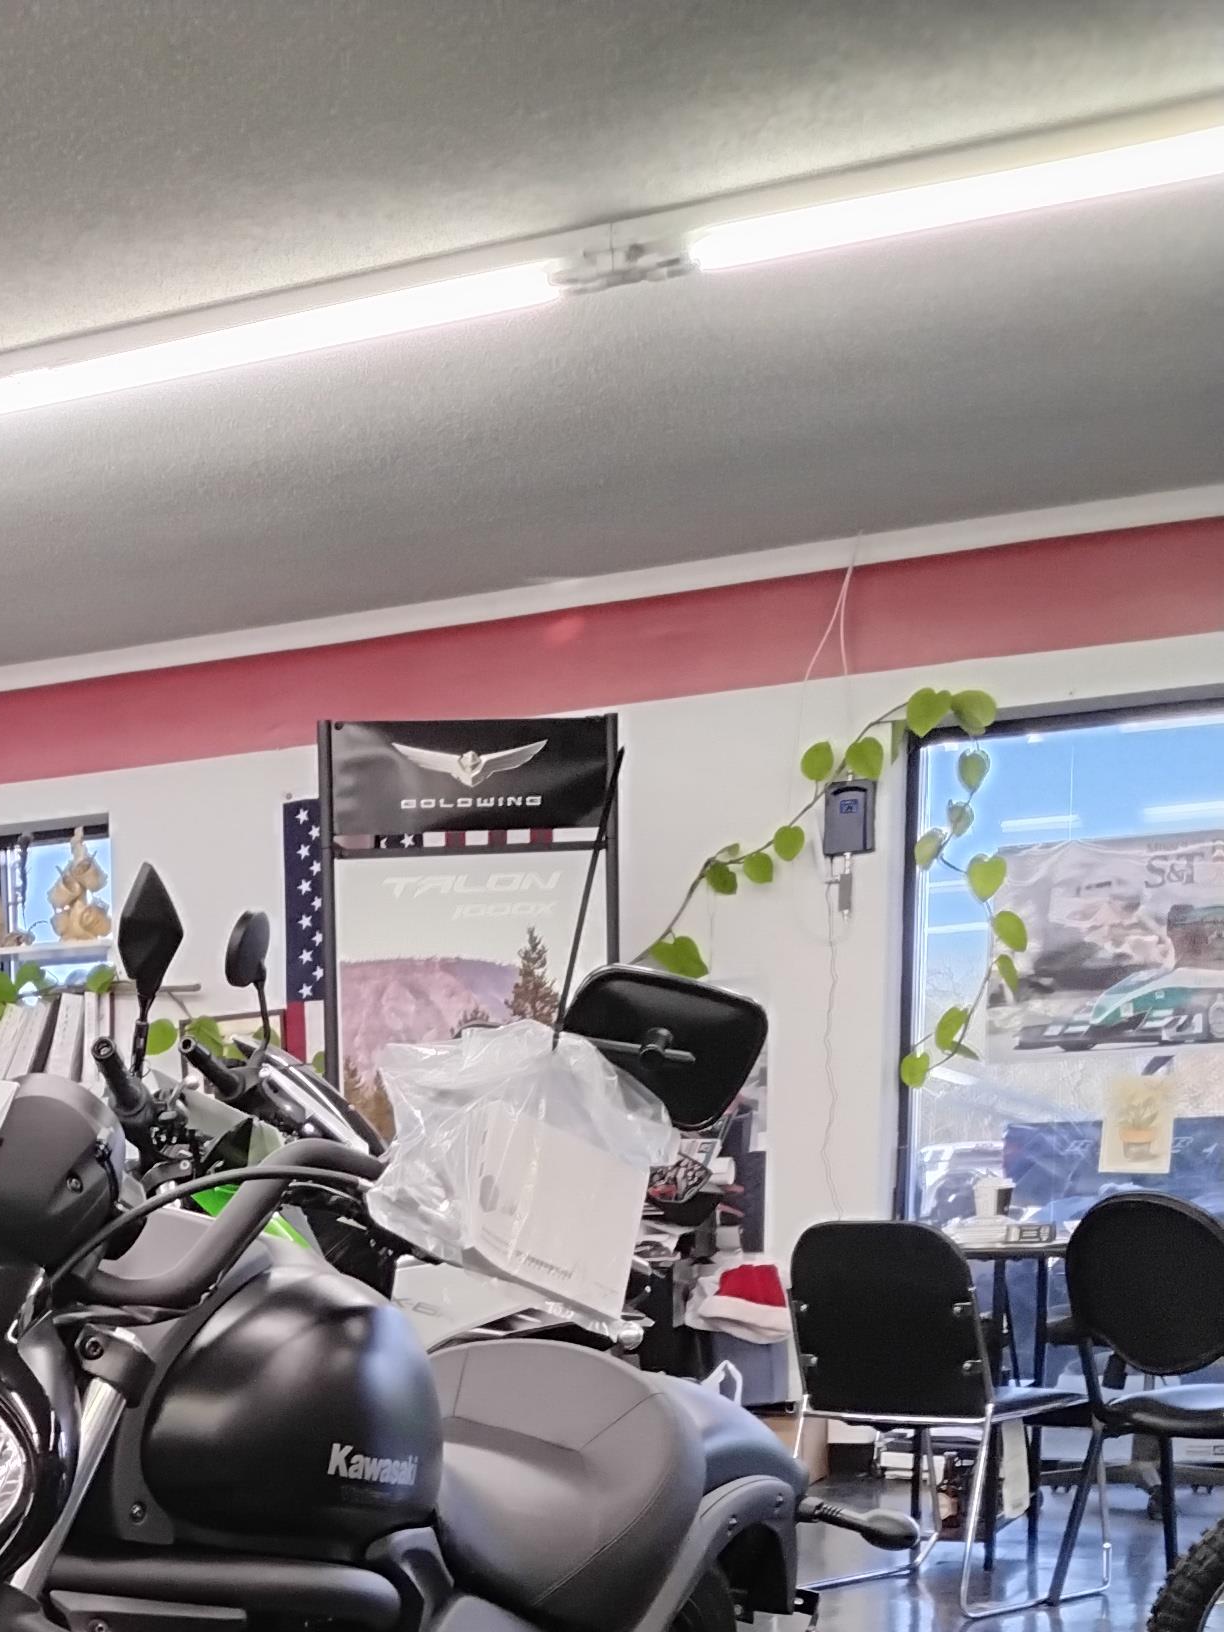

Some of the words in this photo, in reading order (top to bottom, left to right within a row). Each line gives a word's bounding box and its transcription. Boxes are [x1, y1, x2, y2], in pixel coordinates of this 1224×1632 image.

[400, 795, 542, 809] GOLDWING
[381, 869, 562, 898] TALON
[327, 1443, 418, 1486] Kawasaki
